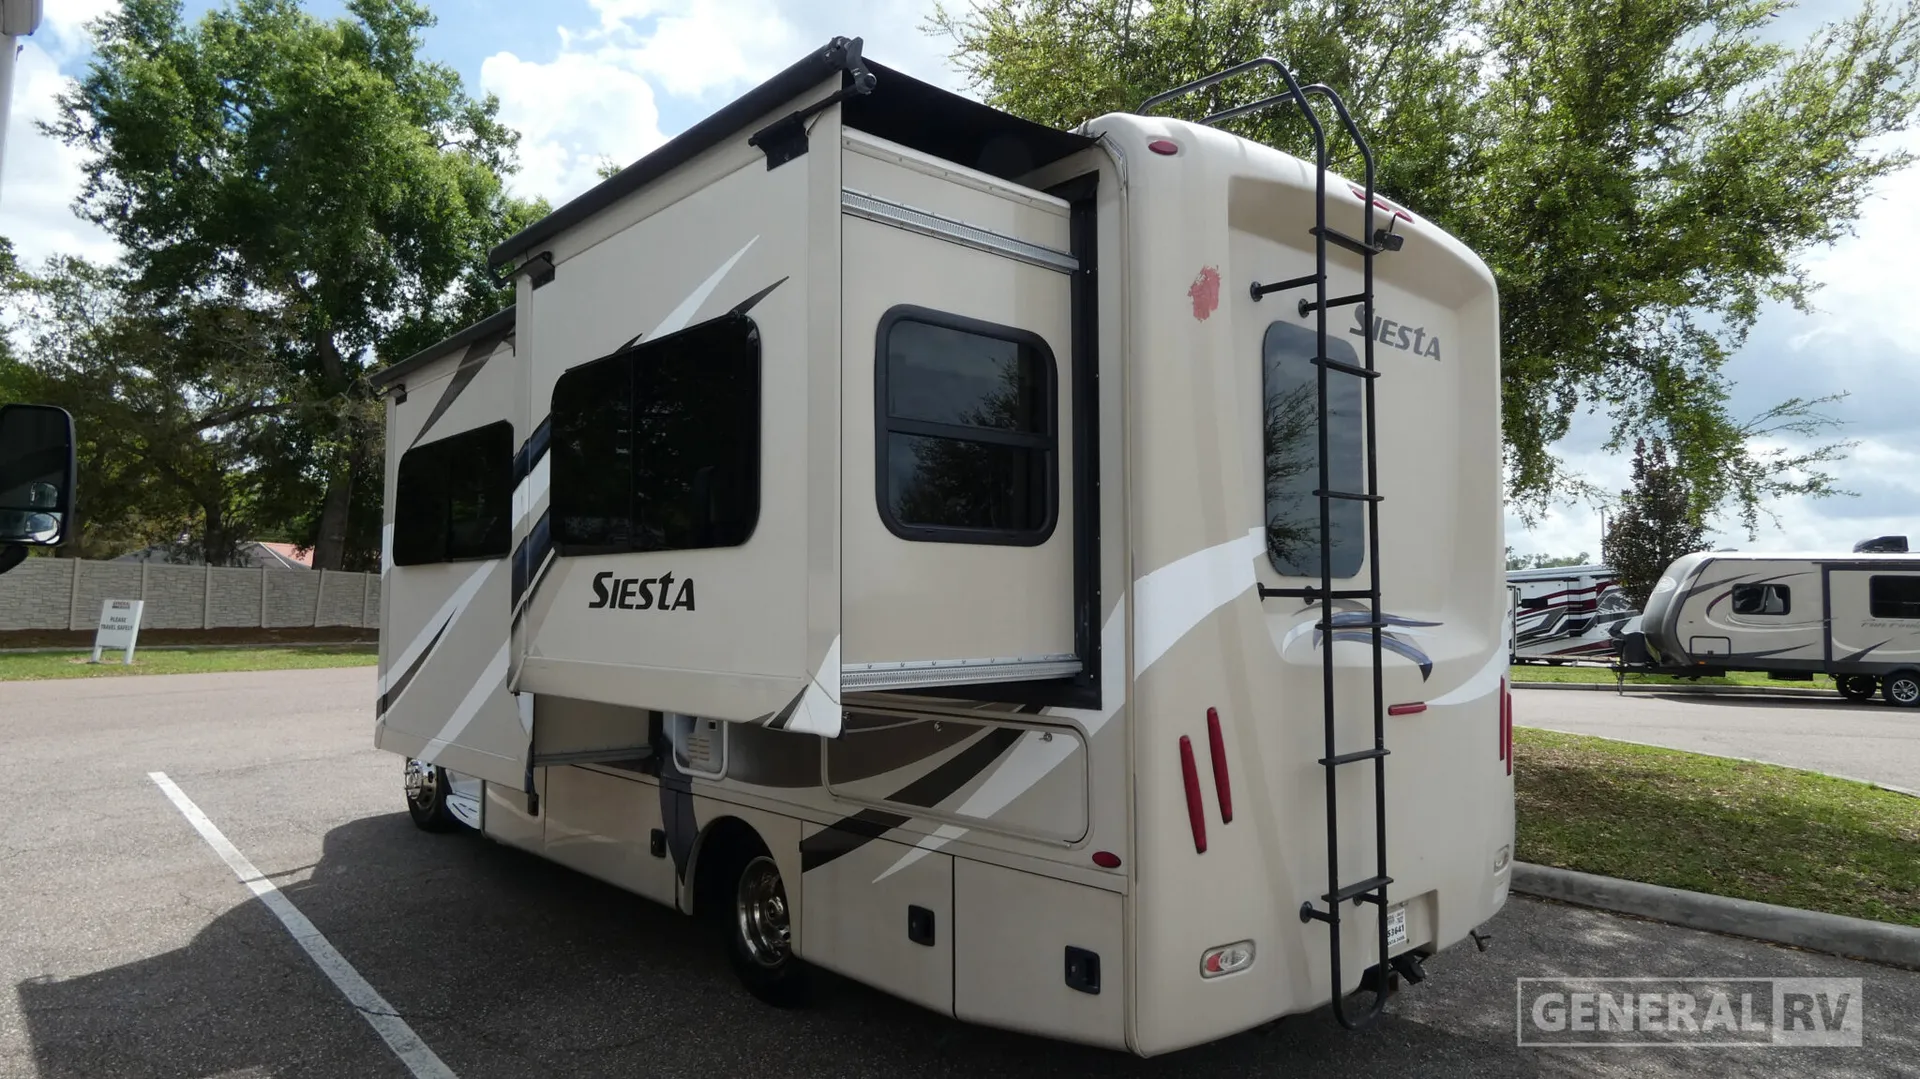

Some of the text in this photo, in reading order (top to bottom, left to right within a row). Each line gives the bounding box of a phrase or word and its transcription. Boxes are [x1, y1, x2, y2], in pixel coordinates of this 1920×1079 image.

[1349, 303, 1441, 362] SIESTA
[588, 570, 696, 612] SIESTA
[101, 623, 116, 631] TRAVEL
